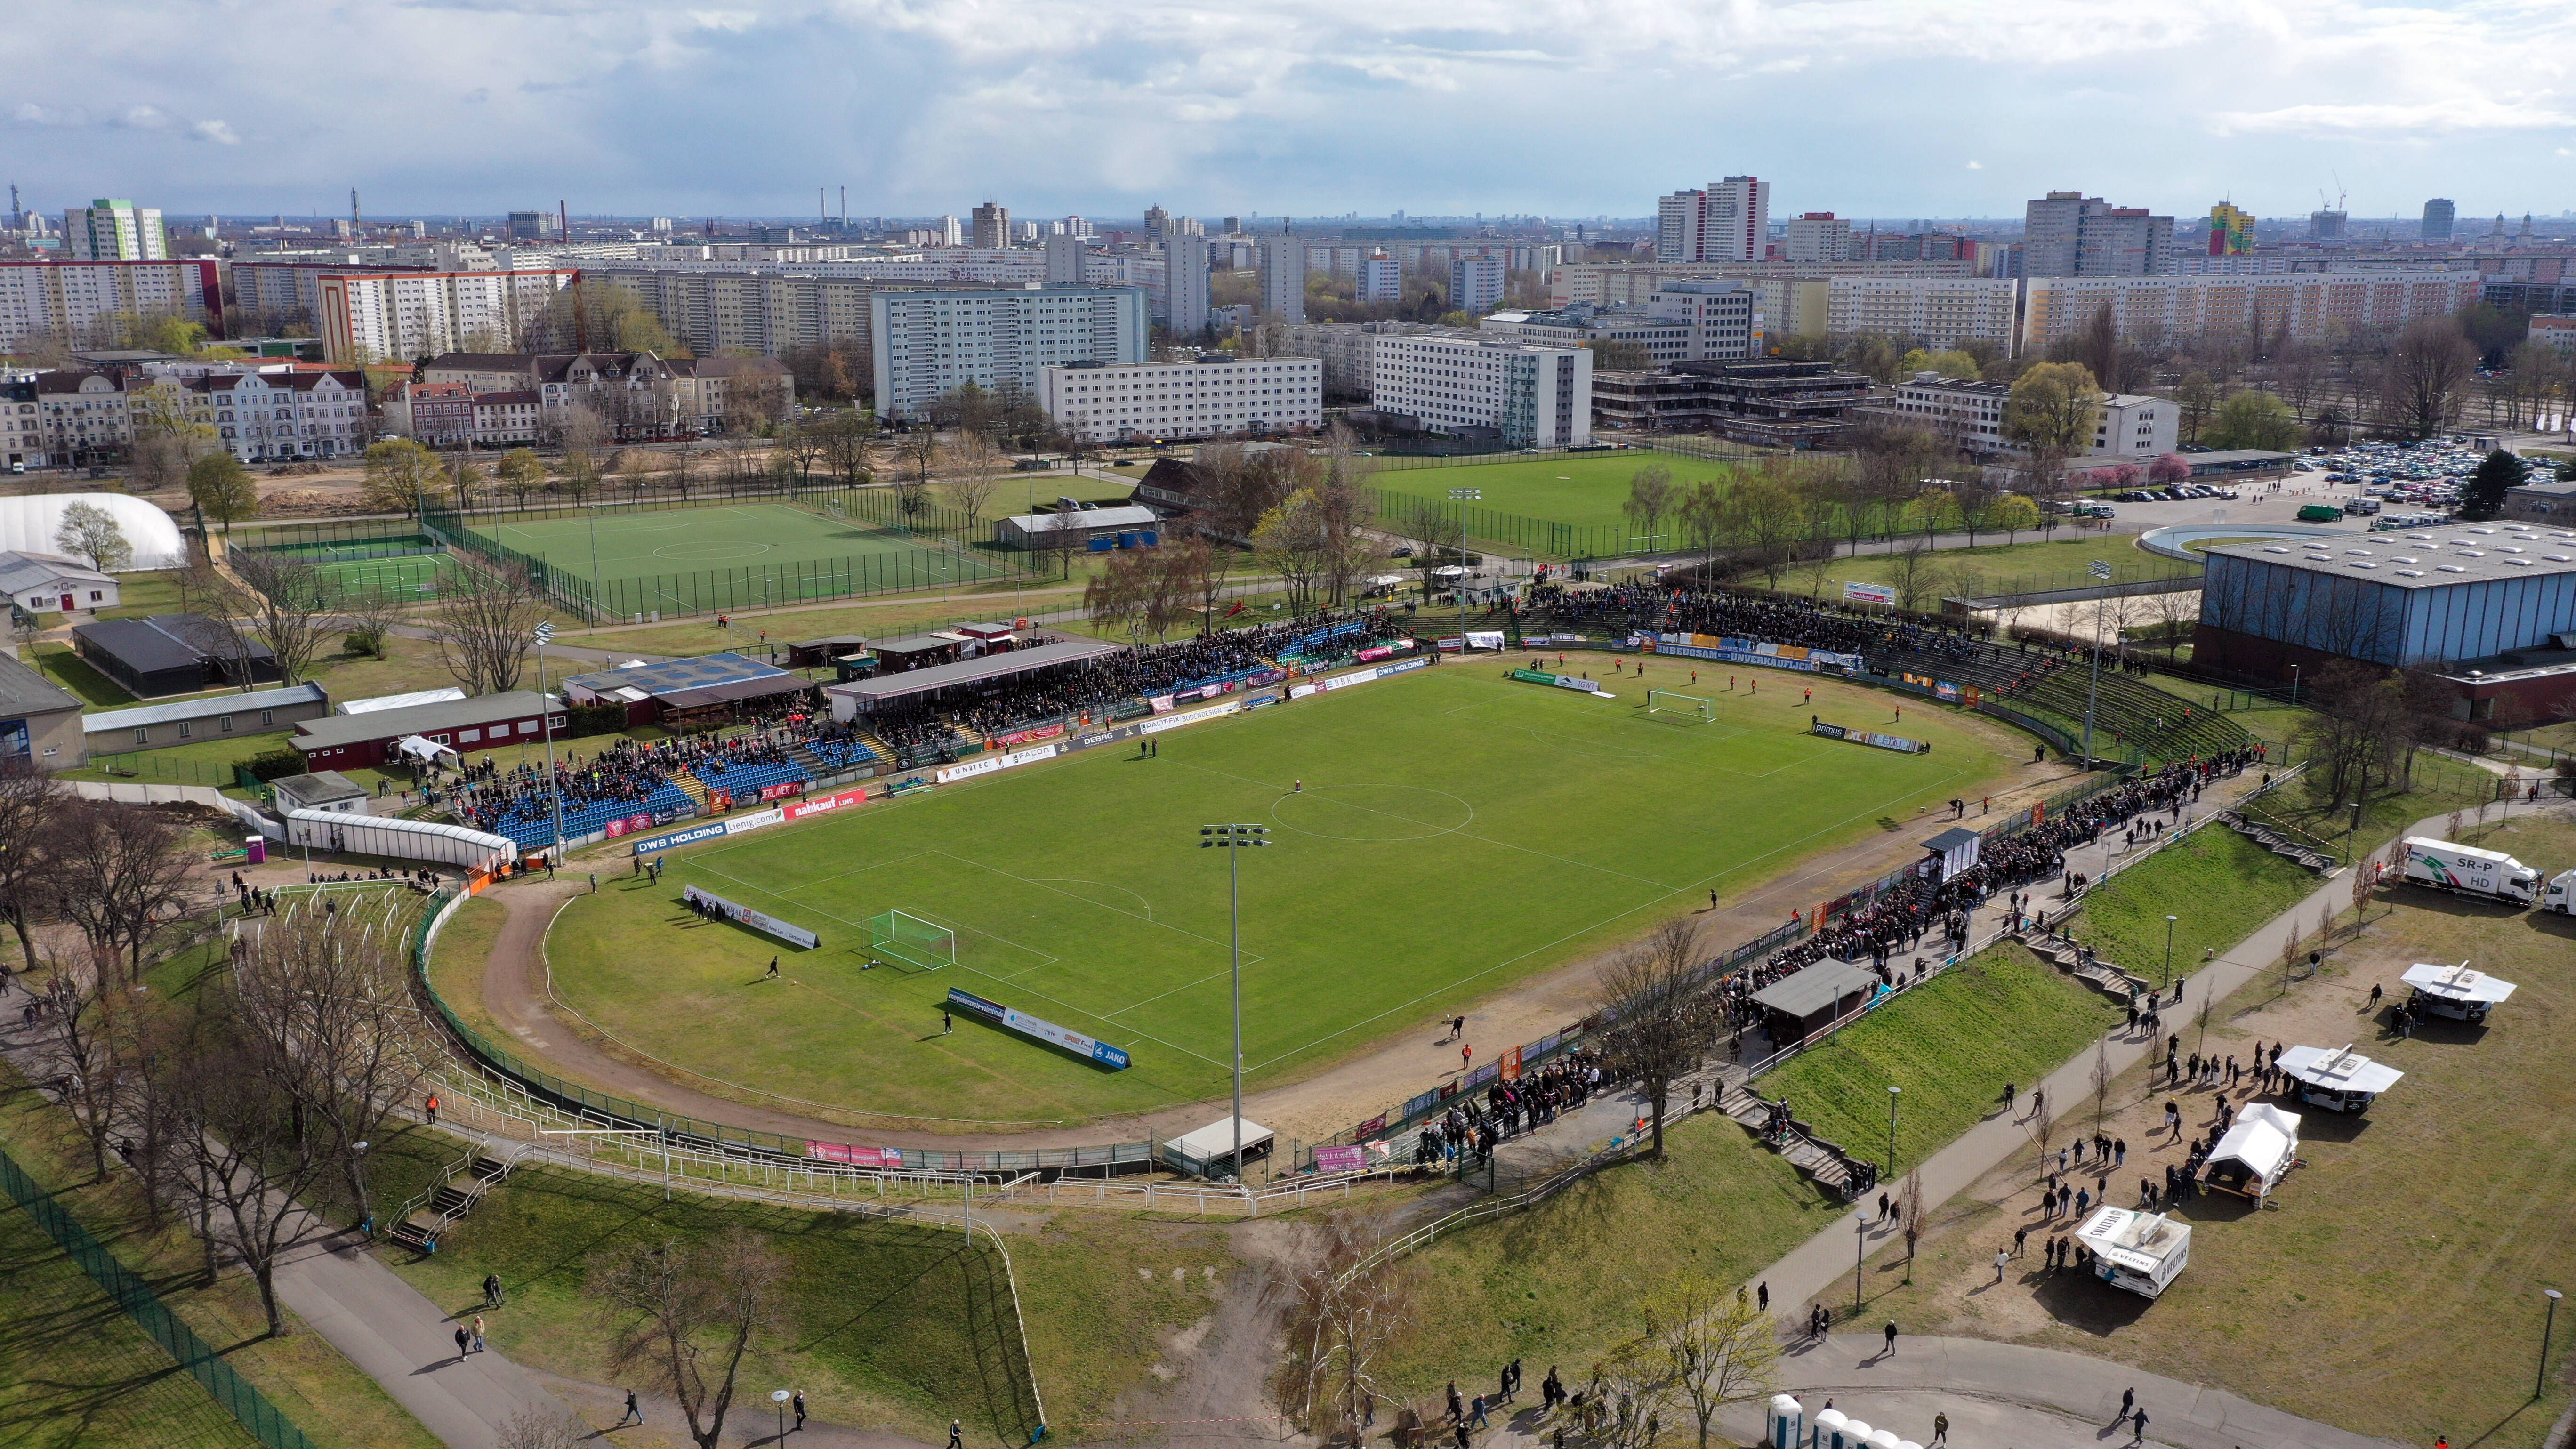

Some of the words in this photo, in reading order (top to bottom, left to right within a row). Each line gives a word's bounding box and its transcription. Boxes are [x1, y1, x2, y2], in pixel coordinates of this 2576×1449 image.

[1656, 644, 1717, 659] UNBEUGSAM
[1730, 652, 1812, 671] UNVERKÄUFLICH
[1378, 666, 1393, 676] DWB
[1395, 660, 1424, 672] HOLDING
[1578, 680, 1595, 690] IGWT
[1182, 708, 1222, 722] BODENDESIGN
[1146, 716, 1180, 729] PAINT-FIX
[1816, 724, 1843, 736] primus
[1849, 731, 1862, 741] XL
[1084, 733, 1113, 745] DEBAG
[1019, 747, 1049, 759] FACON
[762, 785, 790, 799] BERLINER
[794, 797, 837, 817] nahkauf
[838, 797, 854, 806] LIND
[727, 813, 774, 831] Lienig.com
[638, 838, 667, 852] DWB
[670, 825, 724, 845] HOLDING
[2457, 858, 2493, 872] SR-P
[2471, 876, 2490, 888] HD
[725, 905, 742, 917] KMAB
[789, 933, 802, 942] Carsten
[802, 938, 813, 947] Meyer
[948, 993, 1004, 1019] energiekonzepte-valentin.de
[1105, 1050, 1126, 1065] JAKO
[2090, 1216, 2121, 1237] VELTINS
[2119, 1254, 2149, 1267] VELTINS
[2166, 1245, 2188, 1275] VELTINS
